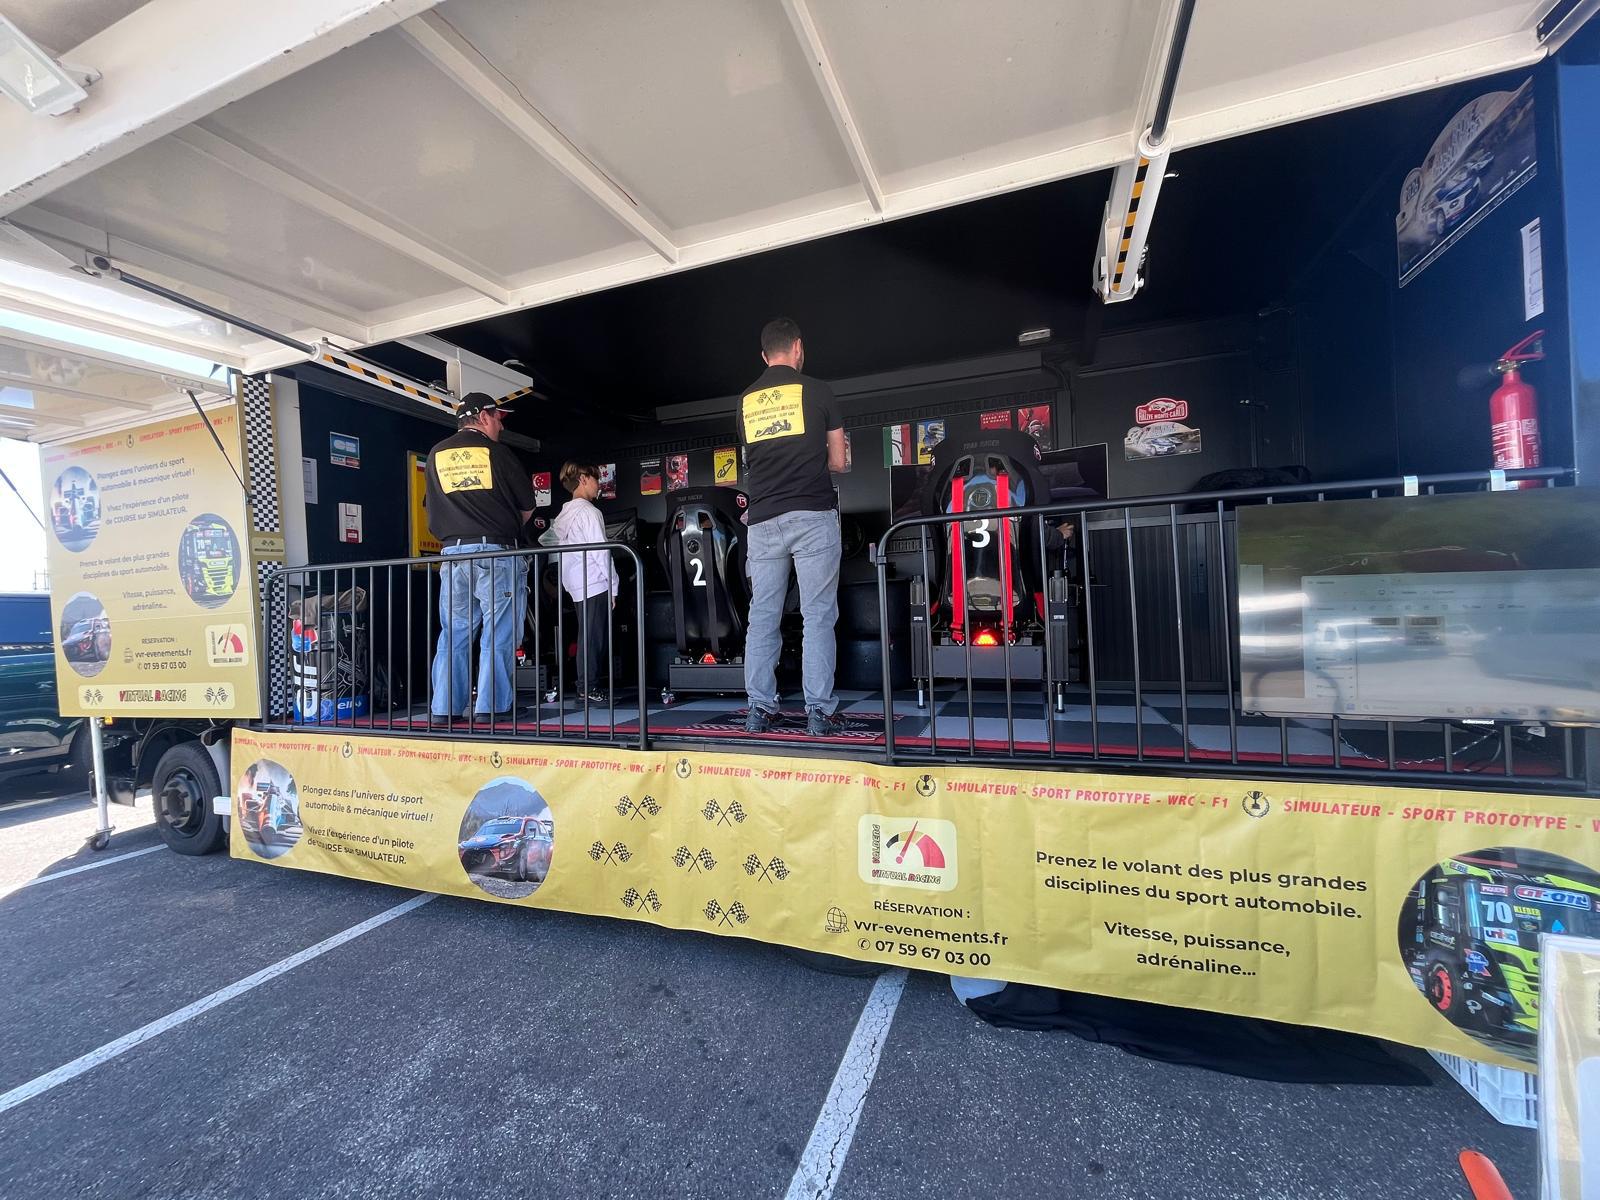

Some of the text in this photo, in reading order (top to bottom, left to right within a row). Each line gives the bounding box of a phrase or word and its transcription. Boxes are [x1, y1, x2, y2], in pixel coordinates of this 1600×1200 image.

[169, 457, 185, 466] sport
[172, 468, 192, 478] virtuel
[114, 514, 136, 524] COURSE
[972, 518, 990, 548] 3
[690, 558, 706, 586] 2
[178, 661, 187, 669] 00
[120, 690, 187, 702] VIRTUAL RACING
[358, 747, 392, 757] SIMULATEUR
[506, 757, 666, 774] SIMULATEUR SPORT PROTOTYPE WRC F1
[698, 765, 752, 778] SIMULATEUR
[762, 770, 792, 781] SPORT
[795, 772, 851, 785] PROTOTYPE
[863, 777, 881, 790] WRC
[893, 781, 906, 791] F1
[302, 784, 424, 806] Plongez dans l'univers du sport
[946, 781, 1018, 796] SIMULATEUR
[1031, 786, 1072, 800] SPORT
[1075, 790, 1151, 805] PROTOTYPE
[1167, 795, 1195, 807] WRC
[1211, 798, 1229, 809] F1
[305, 802, 345, 814] automobile
[346, 806, 352, 814] &
[353, 806, 399, 822] mécanique
[400, 809, 429, 822] virtuel
[1284, 800, 1381, 817] SIMULATEUR
[1402, 807, 1456, 822] SPORT
[1464, 810, 1567, 830] PROTOTYPE
[326, 828, 370, 844] l'expérience
[372, 835, 390, 846] d'un
[391, 838, 415, 850] pilote
[872, 870, 941, 884] VIRTUAL RACING
[1036, 850, 1368, 892] Prenez le volant des plus grandes
[1044, 876, 1362, 919] disciplines du sport automobile.
[874, 900, 963, 918] RÉSERVATION
[1481, 901, 1513, 924] 70
[854, 920, 1009, 946] vvr-evenements.fr
[1104, 921, 1291, 957] Vitesse, puissance,
[875, 940, 991, 966] 07 59 67 03 00
[1136, 951, 1256, 977] adrénaline...
